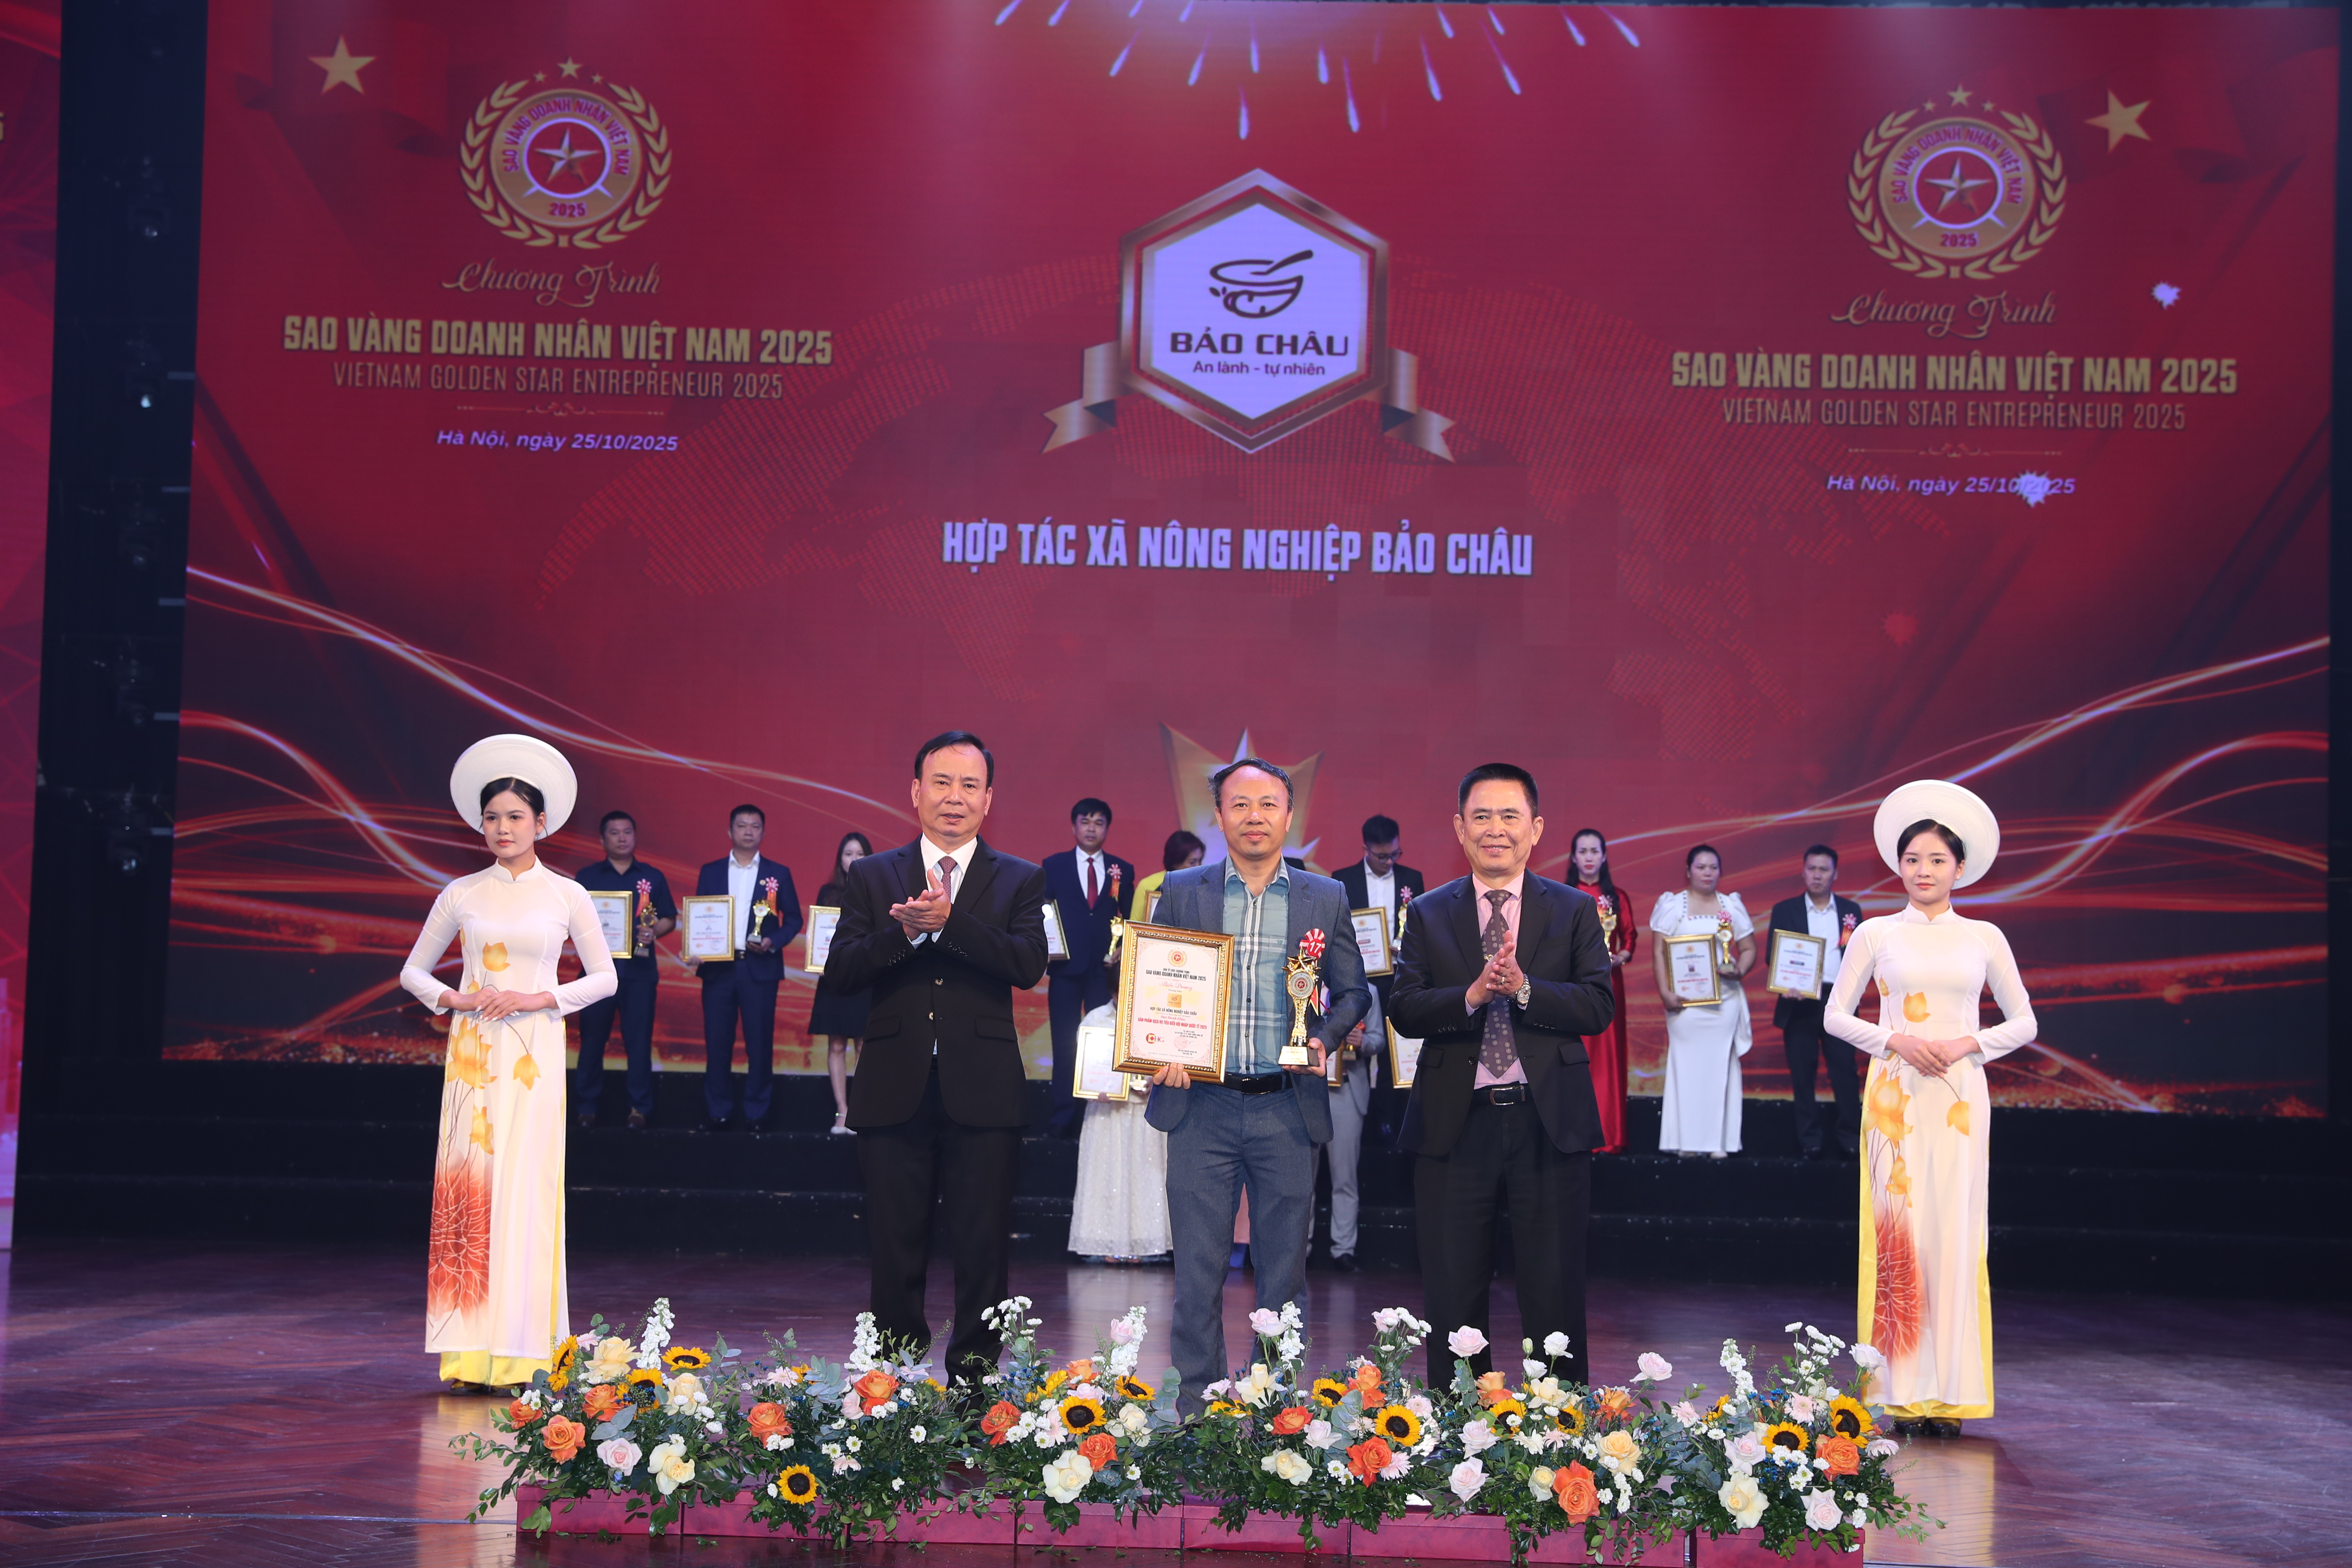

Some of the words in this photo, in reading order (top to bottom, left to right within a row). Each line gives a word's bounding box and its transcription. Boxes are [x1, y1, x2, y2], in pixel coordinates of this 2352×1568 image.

[528, 97, 572, 121] DOANH
[573, 98, 611, 123] NHÂN
[504, 115, 532, 146] VÀNG
[503, 150, 518, 172] SAO
[614, 149, 632, 176] NAM
[1892, 180, 1908, 203] SAO
[1917, 126, 1962, 150] DOANH
[1964, 126, 2004, 151] NHÂN
[2006, 177, 2025, 205] NAM
[548, 202, 586, 217] 2025
[1940, 232, 1978, 248] 2025
[441, 257, 566, 306] Chương
[575, 261, 661, 303] Trình
[1831, 288, 1957, 338] Chương
[1967, 290, 2057, 333] Trình
[284, 315, 338, 350] SAO
[347, 311, 422, 354] VÀNG
[431, 319, 525, 356] DOANH
[534, 318, 612, 359] NHÂN
[621, 320, 677, 368] VIỆT
[686, 327, 751, 363] NAM
[760, 329, 833, 364] 2025
[1170, 327, 1243, 354] BẢO
[1256, 331, 1348, 356] CHÂU
[333, 361, 421, 388] VIETNAM
[431, 364, 506, 391] GOLDEN
[516, 366, 563, 393] STAR
[573, 369, 723, 398] ENTREPRENEUR
[733, 373, 782, 398] 2025
[1193, 361, 1213, 373] An
[1217, 361, 1249, 374] lành
[1265, 364, 1281, 377] tự
[1284, 362, 1325, 375] nhiên
[1672, 352, 1726, 387] SAO
[1736, 346, 1811, 389] VÀNG
[1820, 353, 1916, 390] DOANH
[1926, 349, 2006, 391] NHÂN
[2015, 350, 2074, 400] VIỆT
[2083, 358, 2151, 392] NAM
[2161, 358, 2237, 394] 2025
[1722, 398, 1812, 424] VIETNAM
[1820, 399, 1898, 426] GOLDEN
[1908, 400, 1957, 426] STAR
[1967, 401, 2122, 429] ENTREPRENEUR
[2134, 403, 2185, 430] 2025
[437, 429, 464, 445] Hà
[469, 430, 508, 448] Nội,
[516, 433, 567, 452] ngày
[571, 434, 678, 451] 25/10/2025
[1827, 475, 1855, 491] Hà
[1861, 475, 1899, 494] Nội,
[1908, 476, 1960, 496] ngày
[943, 518, 1008, 574] HỢP
[1017, 516, 1076, 566] TÁC
[1086, 518, 1128, 567] XÃ
[1138, 519, 1232, 570] NÔNG
[1242, 523, 1361, 582] NGHIỆP
[1371, 519, 1435, 574] BẢO
[1446, 526, 1533, 576] CHÂU
[1310, 941, 1322, 953] 17
